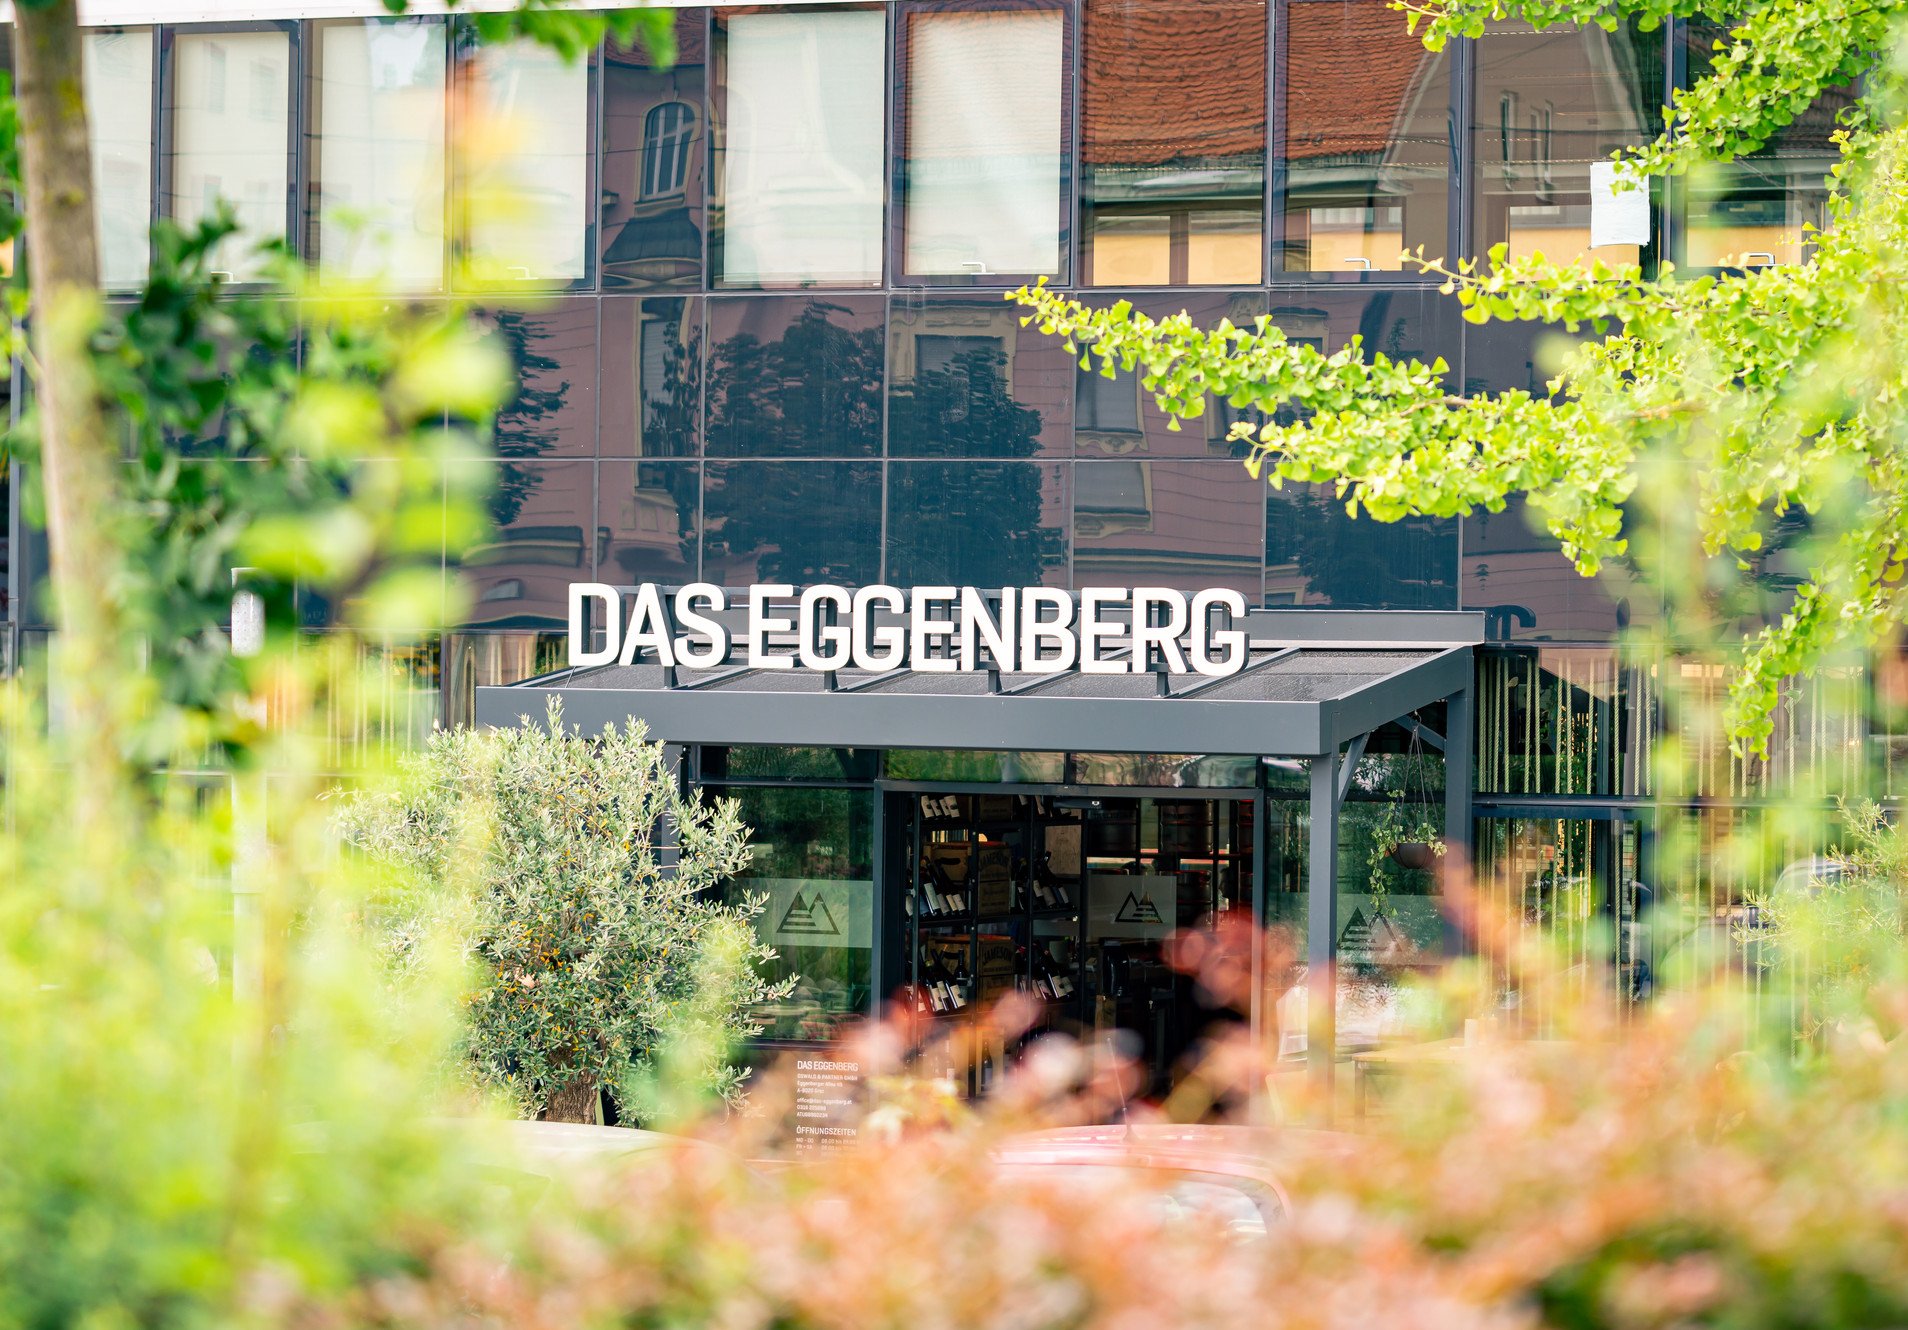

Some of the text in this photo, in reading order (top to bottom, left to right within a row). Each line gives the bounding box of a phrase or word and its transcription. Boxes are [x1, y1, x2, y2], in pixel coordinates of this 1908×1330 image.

[567, 582, 1249, 678] DAS EGGENBERG
[983, 946, 1013, 965] JAMESON
[797, 1060, 859, 1072] DAS EGGENBERG
[796, 1125, 857, 1136] ÖFFNUNGSZEITEN
